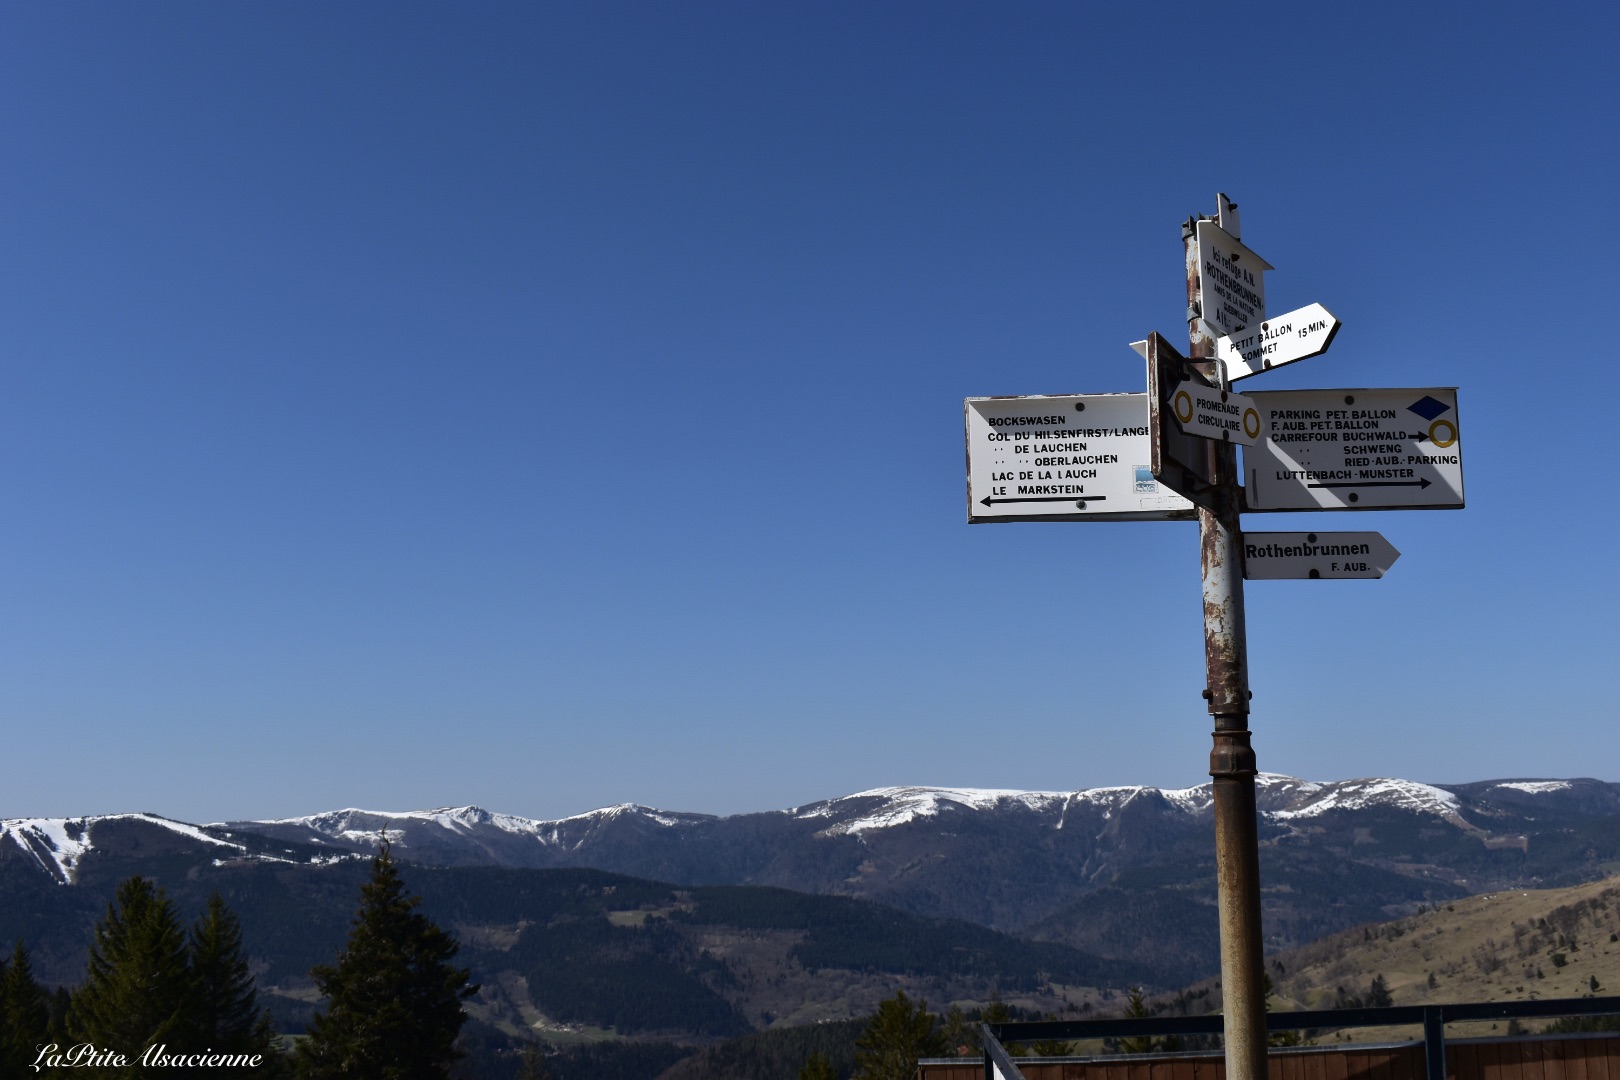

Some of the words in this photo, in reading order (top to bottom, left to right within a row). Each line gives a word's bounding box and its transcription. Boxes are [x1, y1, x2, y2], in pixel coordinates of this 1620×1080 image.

[1222, 257, 1241, 279] refuge
[1214, 283, 1225, 297] AMIS
[1226, 291, 1231, 302] DE
[1233, 295, 1238, 306] LA
[1239, 300, 1254, 317] NATURE
[1224, 302, 1247, 323] GUEBWILLER
[1231, 337, 1253, 352] PETIT
[1258, 323, 1292, 343] BALLON
[1298, 328, 1307, 338] 15
[1309, 320, 1328, 333] MIN.
[1242, 343, 1277, 362] SOMMET
[1197, 398, 1239, 415] PROMENADE
[1271, 410, 1320, 419] PARKING
[1352, 409, 1396, 419] BALLON
[989, 415, 1065, 427] BOCKSWASEN
[1198, 414, 1240, 431] CIRCULAIRE
[1272, 422, 1279, 430] F.
[1283, 421, 1308, 430] AUB.
[1310, 421, 1332, 430] PET.
[1335, 420, 1378, 429] BALLON
[988, 433, 1010, 442] COL
[1015, 431, 1030, 440] DU
[1271, 433, 1338, 442] CARREFOUR
[1343, 431, 1407, 441] BUCHWALD
[1015, 445, 1029, 453] DE
[1034, 443, 1087, 453] LAUCHEN
[1344, 445, 1402, 454] SCHWENG
[1035, 455, 1117, 466] OBERLAUCHEN
[992, 472, 1014, 481] LAC
[1019, 471, 1033, 480] DE
[1038, 471, 1052, 480] LA
[993, 487, 1006, 496] LE
[1018, 485, 1084, 495] MARKSTEIN
[1246, 543, 1369, 558] Rothenbrunnen
[1332, 563, 1339, 571] F.
[1344, 562, 1371, 571] AUB.
